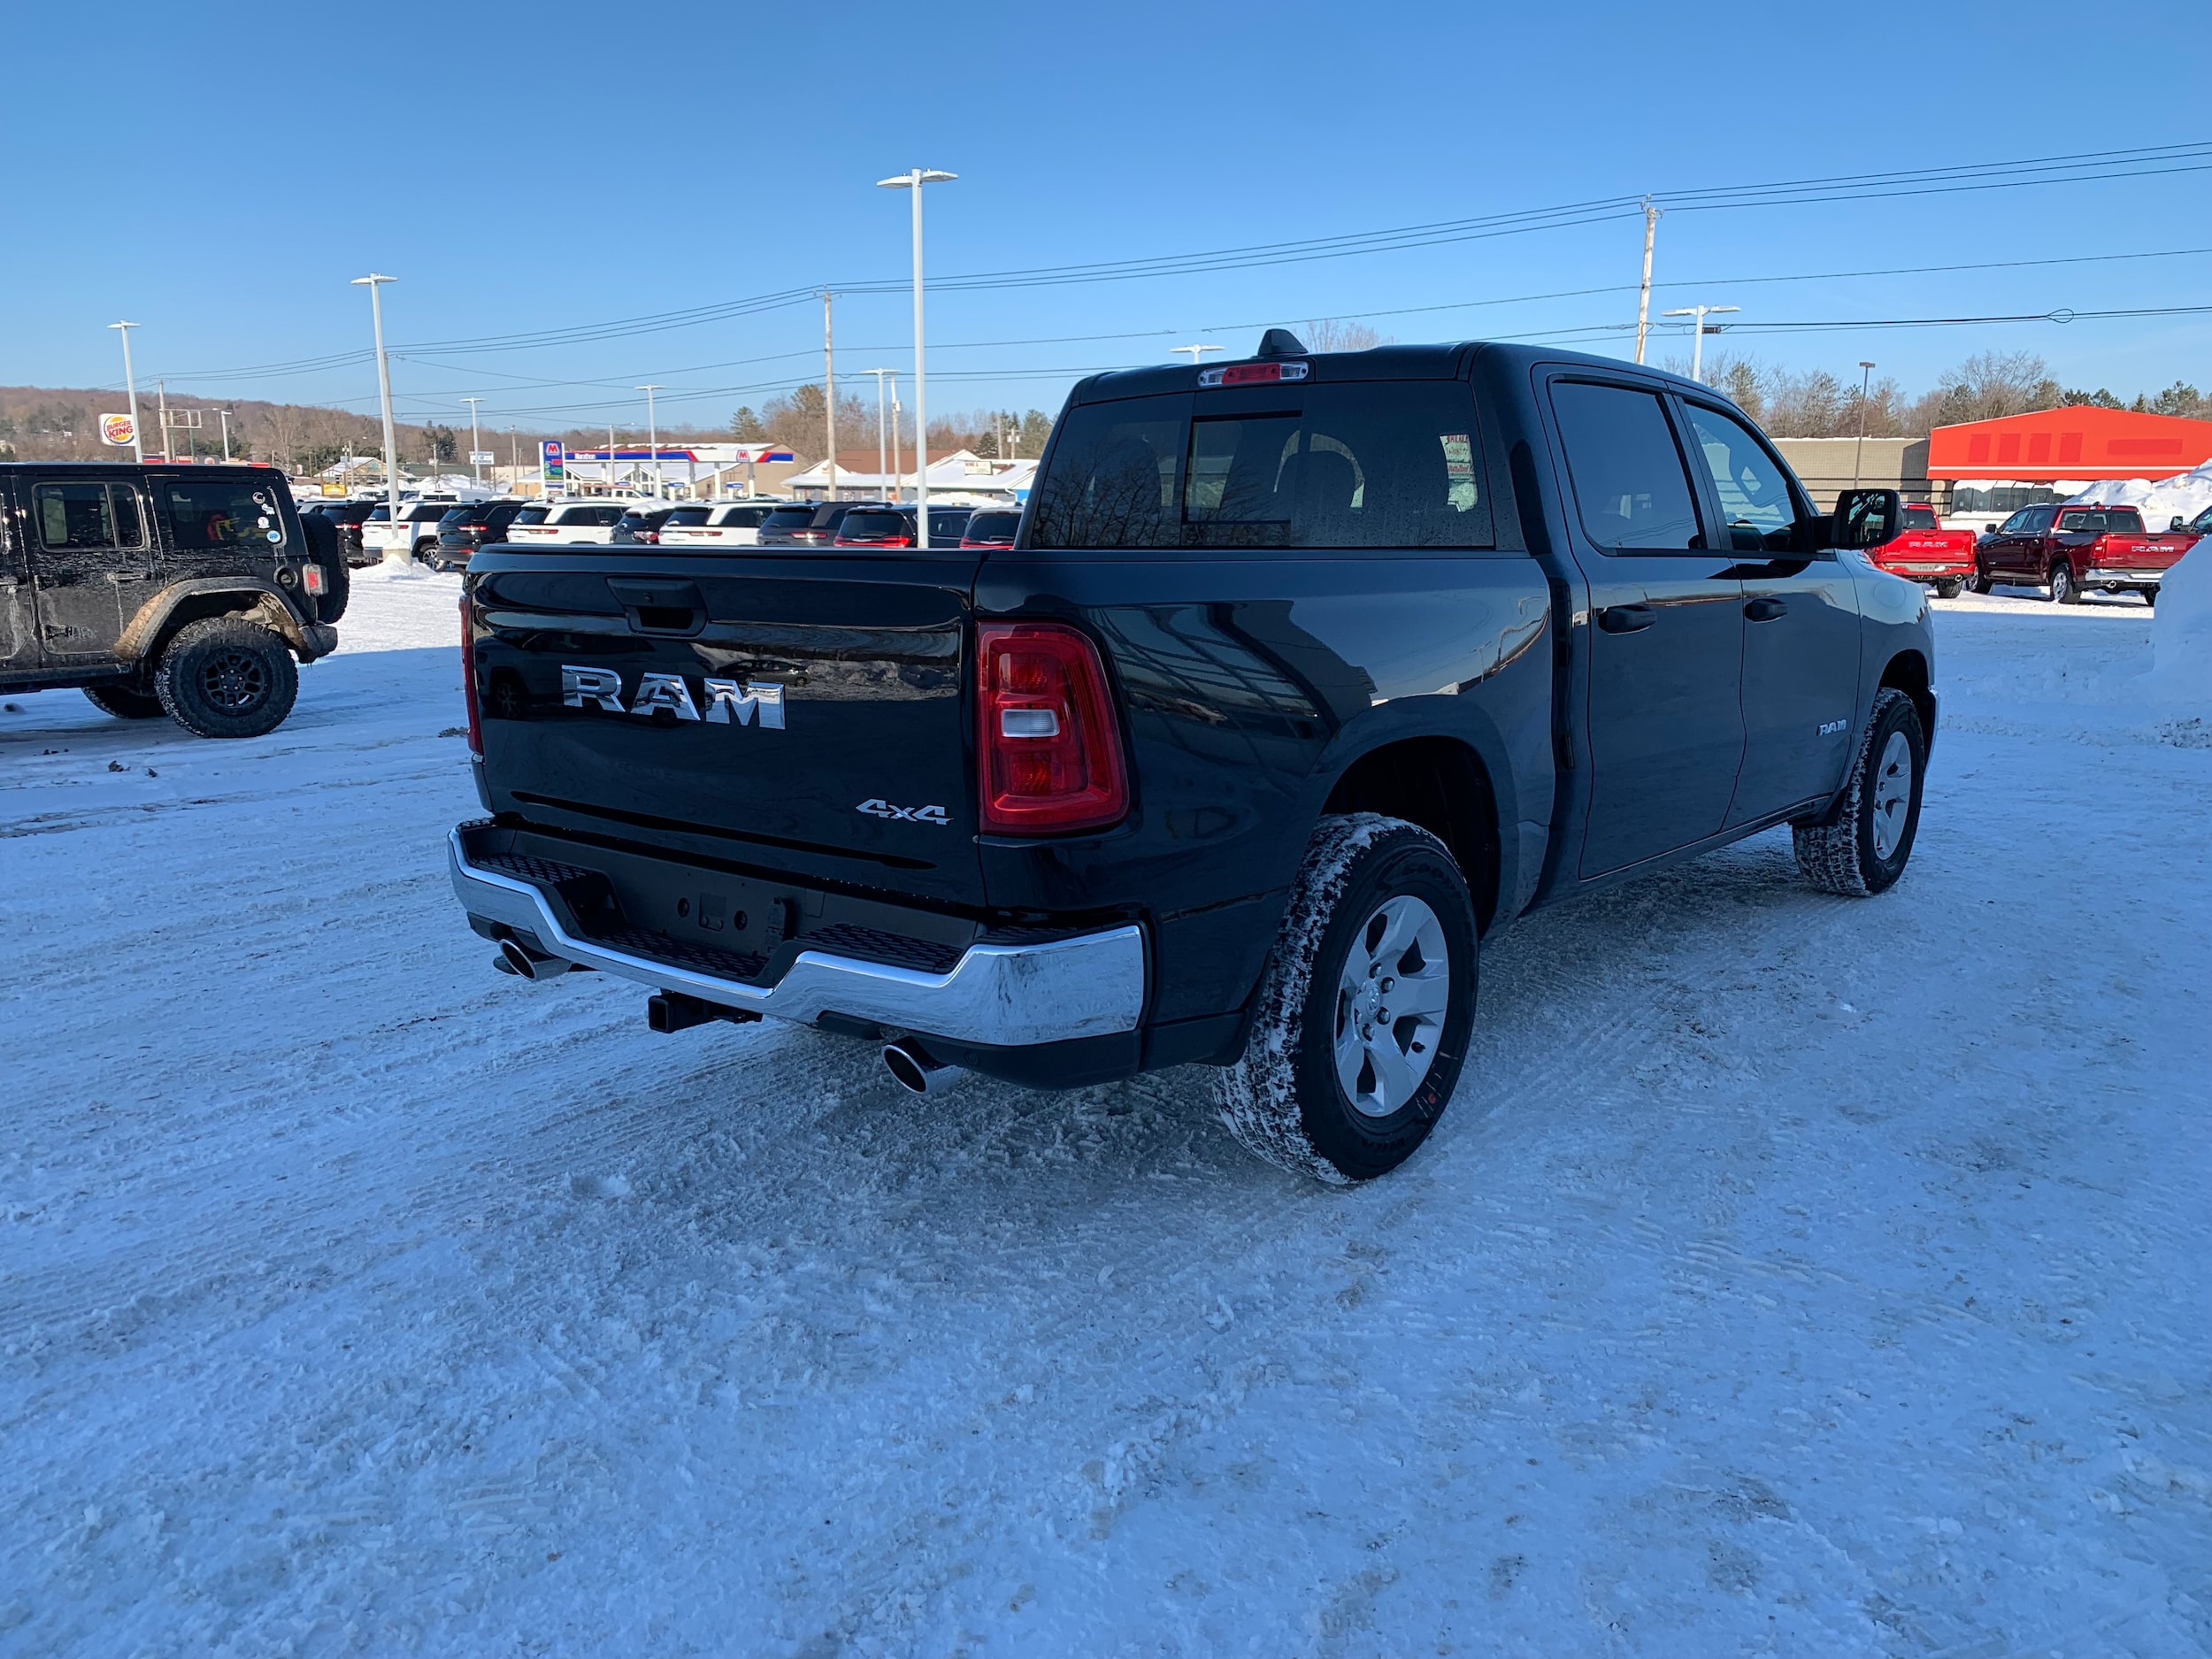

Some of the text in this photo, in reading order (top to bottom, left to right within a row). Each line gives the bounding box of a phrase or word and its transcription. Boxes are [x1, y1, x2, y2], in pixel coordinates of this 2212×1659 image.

[106, 420, 132, 431] BURGER
[108, 426, 134, 439] KING
[561, 664, 786, 730] RAM
[1816, 718, 1847, 736] RAM
[855, 798, 955, 826] 4x4
